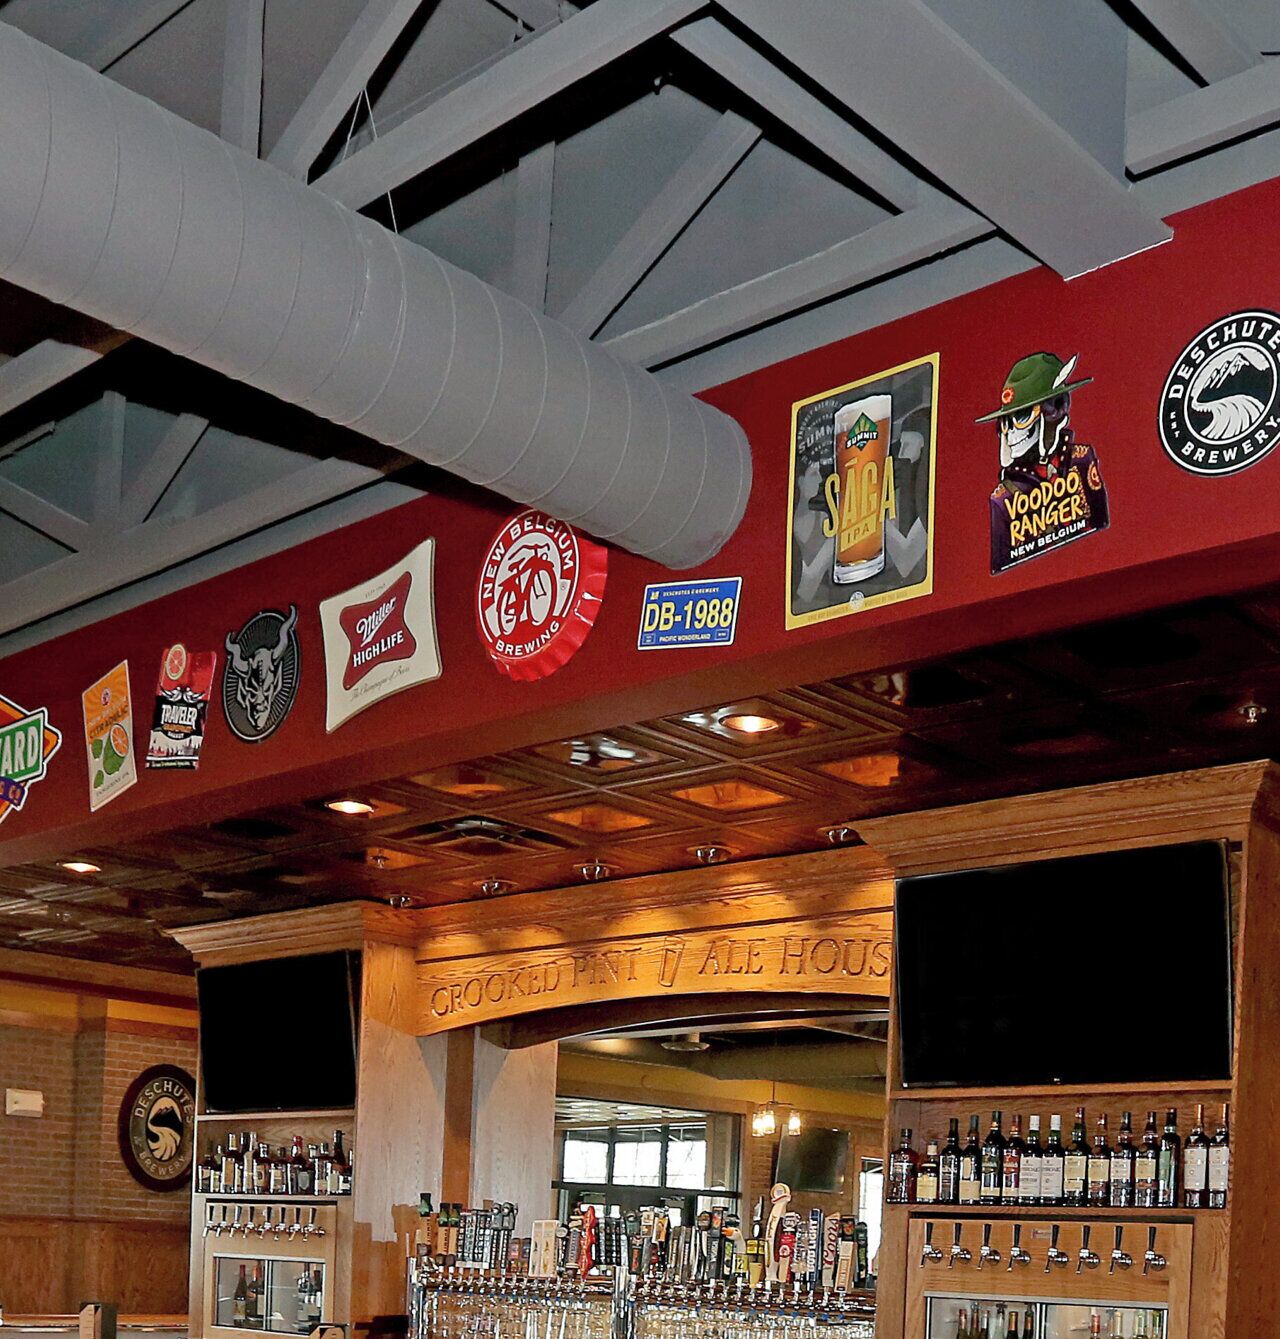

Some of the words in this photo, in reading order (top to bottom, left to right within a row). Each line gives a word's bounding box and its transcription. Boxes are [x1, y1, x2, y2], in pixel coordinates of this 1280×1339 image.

[846, 431, 878, 449] SUMMIT
[1004, 471, 1080, 520] VOODOO
[847, 521, 870, 544] IPA
[1010, 495, 1084, 547] RANGER
[1010, 541, 1035, 559] NEW
[1037, 520, 1086, 548] BELGIUM
[483, 542, 506, 599] NEW
[509, 515, 574, 571] BELGIUM
[356, 597, 397, 648] Miller
[643, 597, 734, 633] DB-1988
[353, 643, 380, 668] HIGH
[381, 630, 404, 654] LIFE
[495, 620, 560, 657] BREWING
[160, 704, 198, 730] TRAVELER
[429, 960, 561, 1019] CROOKED
[570, 947, 642, 989] PINT
[698, 938, 767, 977] ALE
[779, 937, 892, 977] HOUS
[134, 1080, 194, 1124] DESCHUTES
[138, 1152, 186, 1176] BREWERY
[810, 1219, 819, 1248] LIGHT
[807, 1249, 816, 1273] BUD
